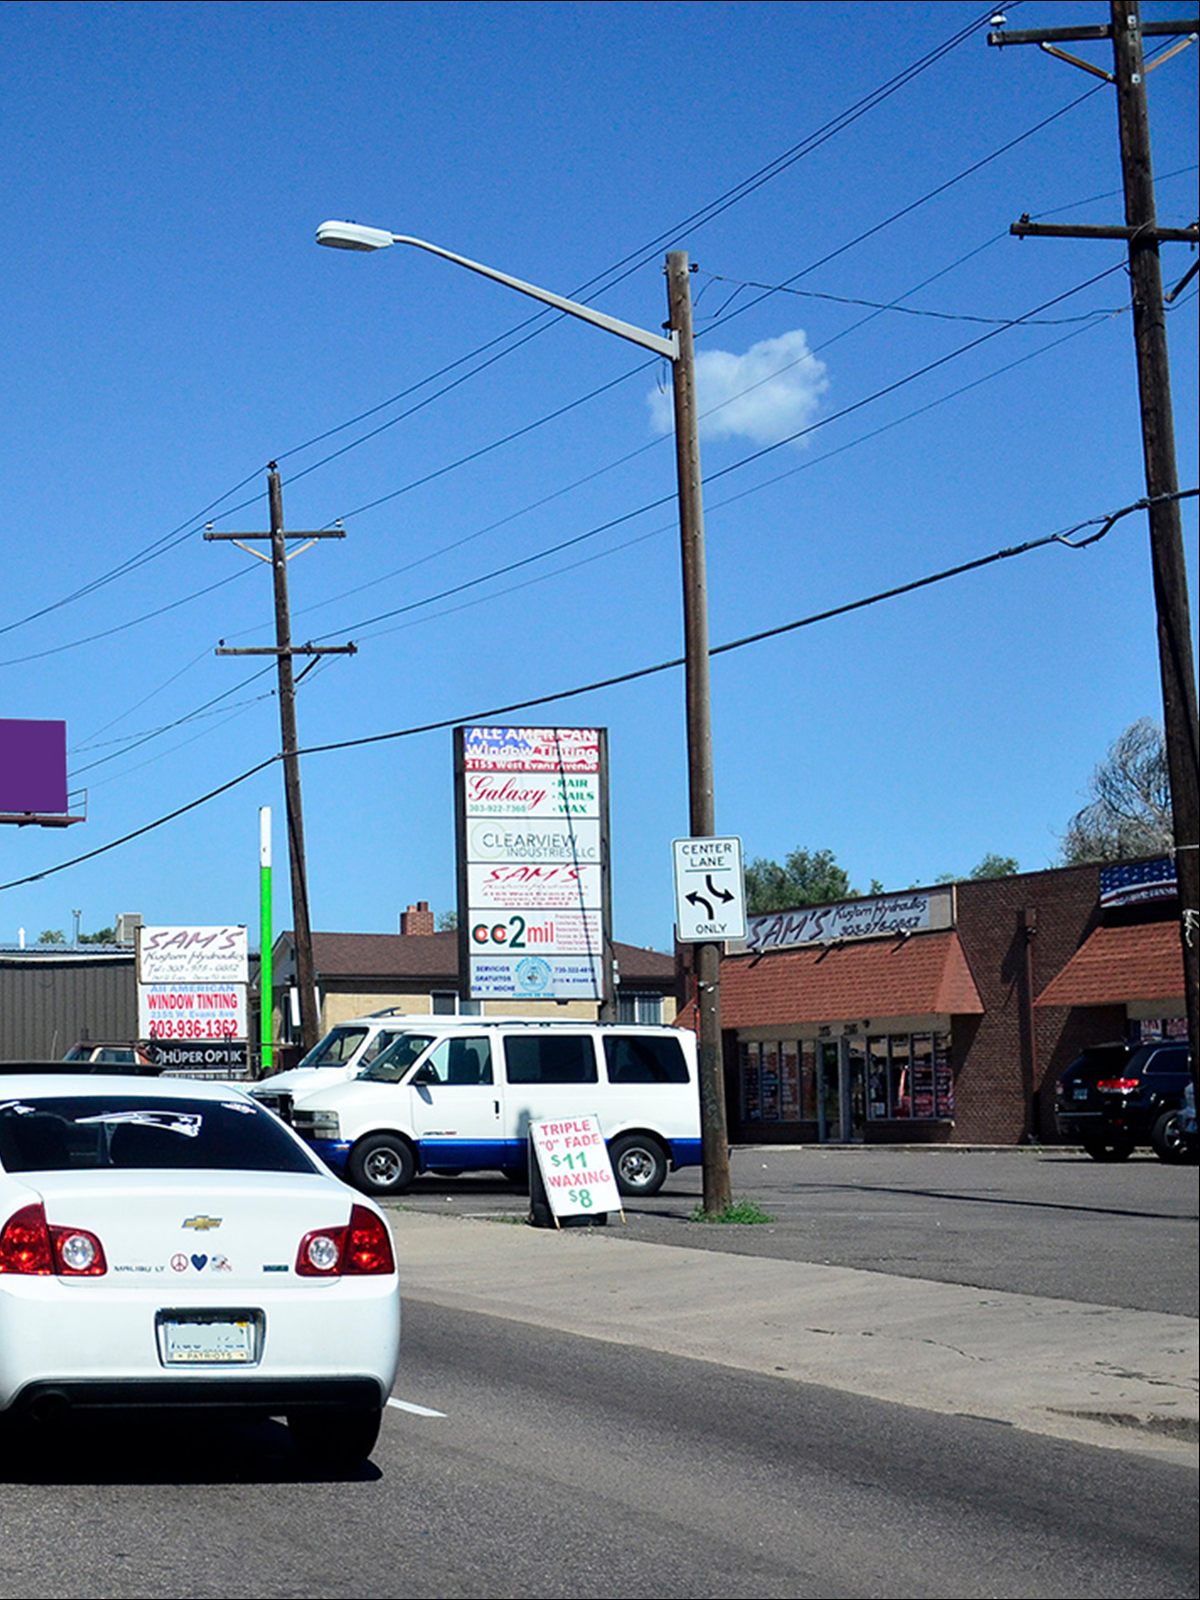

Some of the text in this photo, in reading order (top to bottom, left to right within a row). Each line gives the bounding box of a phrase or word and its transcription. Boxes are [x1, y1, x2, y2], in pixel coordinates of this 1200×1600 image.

[504, 727, 598, 741] AMERICAN
[466, 743, 597, 759] Window Tinting
[466, 760, 598, 771] 2155 West Evans Avenue
[468, 775, 588, 810] Galaxy HAIR
[558, 791, 595, 801] NAILS
[558, 804, 588, 813] WAX
[482, 832, 578, 848] CLEARVIEW
[506, 847, 572, 858] INDUSTRIES
[681, 843, 732, 855] CENTER
[690, 856, 725, 867] LANE
[482, 864, 588, 883] SAM'S
[695, 923, 727, 934] ONLY
[747, 909, 831, 949] SAM'S
[143, 928, 244, 951] SAM'S
[169, 984, 235, 992] AMERICAN
[147, 993, 238, 1009] WINDOW TINTING
[150, 1011, 174, 1019] 2155
[188, 1010, 216, 1019] Evans
[162, 1048, 203, 1064] HÜPER
[540, 1119, 591, 1136] TRIPLE
[564, 1133, 601, 1148] FADE
[550, 1151, 587, 1170] $11
[548, 1169, 611, 1188] WAXING
[568, 1188, 593, 1208] $8
[186, 1352, 232, 1361] PATRIOTS
